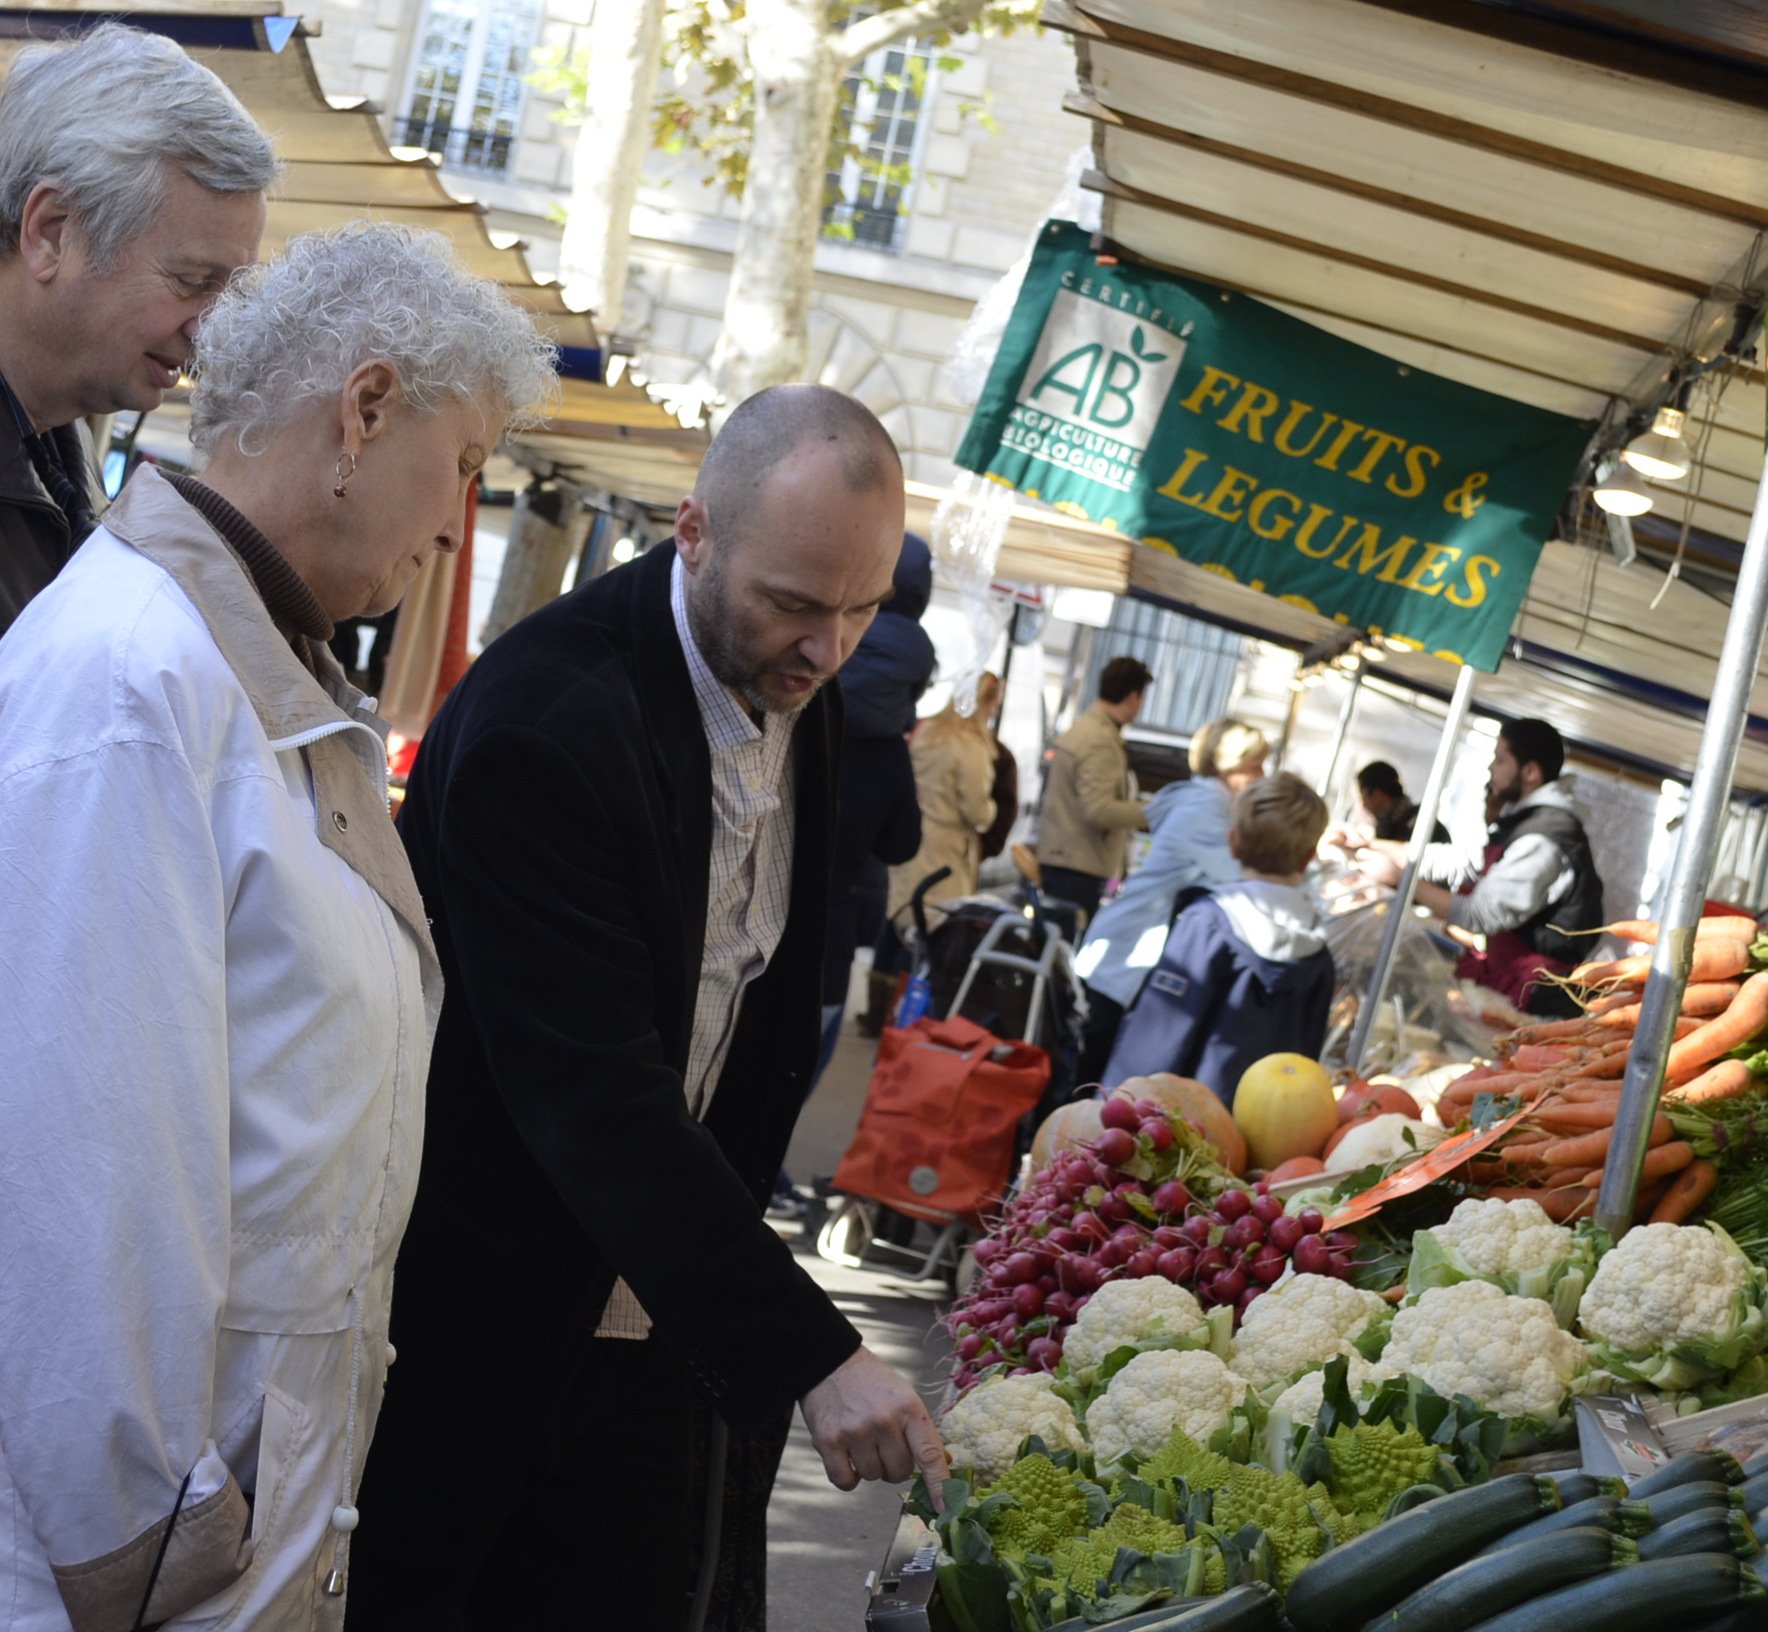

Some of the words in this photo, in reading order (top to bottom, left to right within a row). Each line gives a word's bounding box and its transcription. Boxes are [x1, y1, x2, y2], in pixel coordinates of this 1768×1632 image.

[1030, 343, 1141, 428] AB
[1003, 423, 1138, 486] BIOLOGIQUE
[1009, 406, 1144, 468] AGRICULTURE
[1180, 365, 1441, 498] FRUITS
[1443, 471, 1489, 520] &
[1156, 447, 1502, 609] LEGUMES
